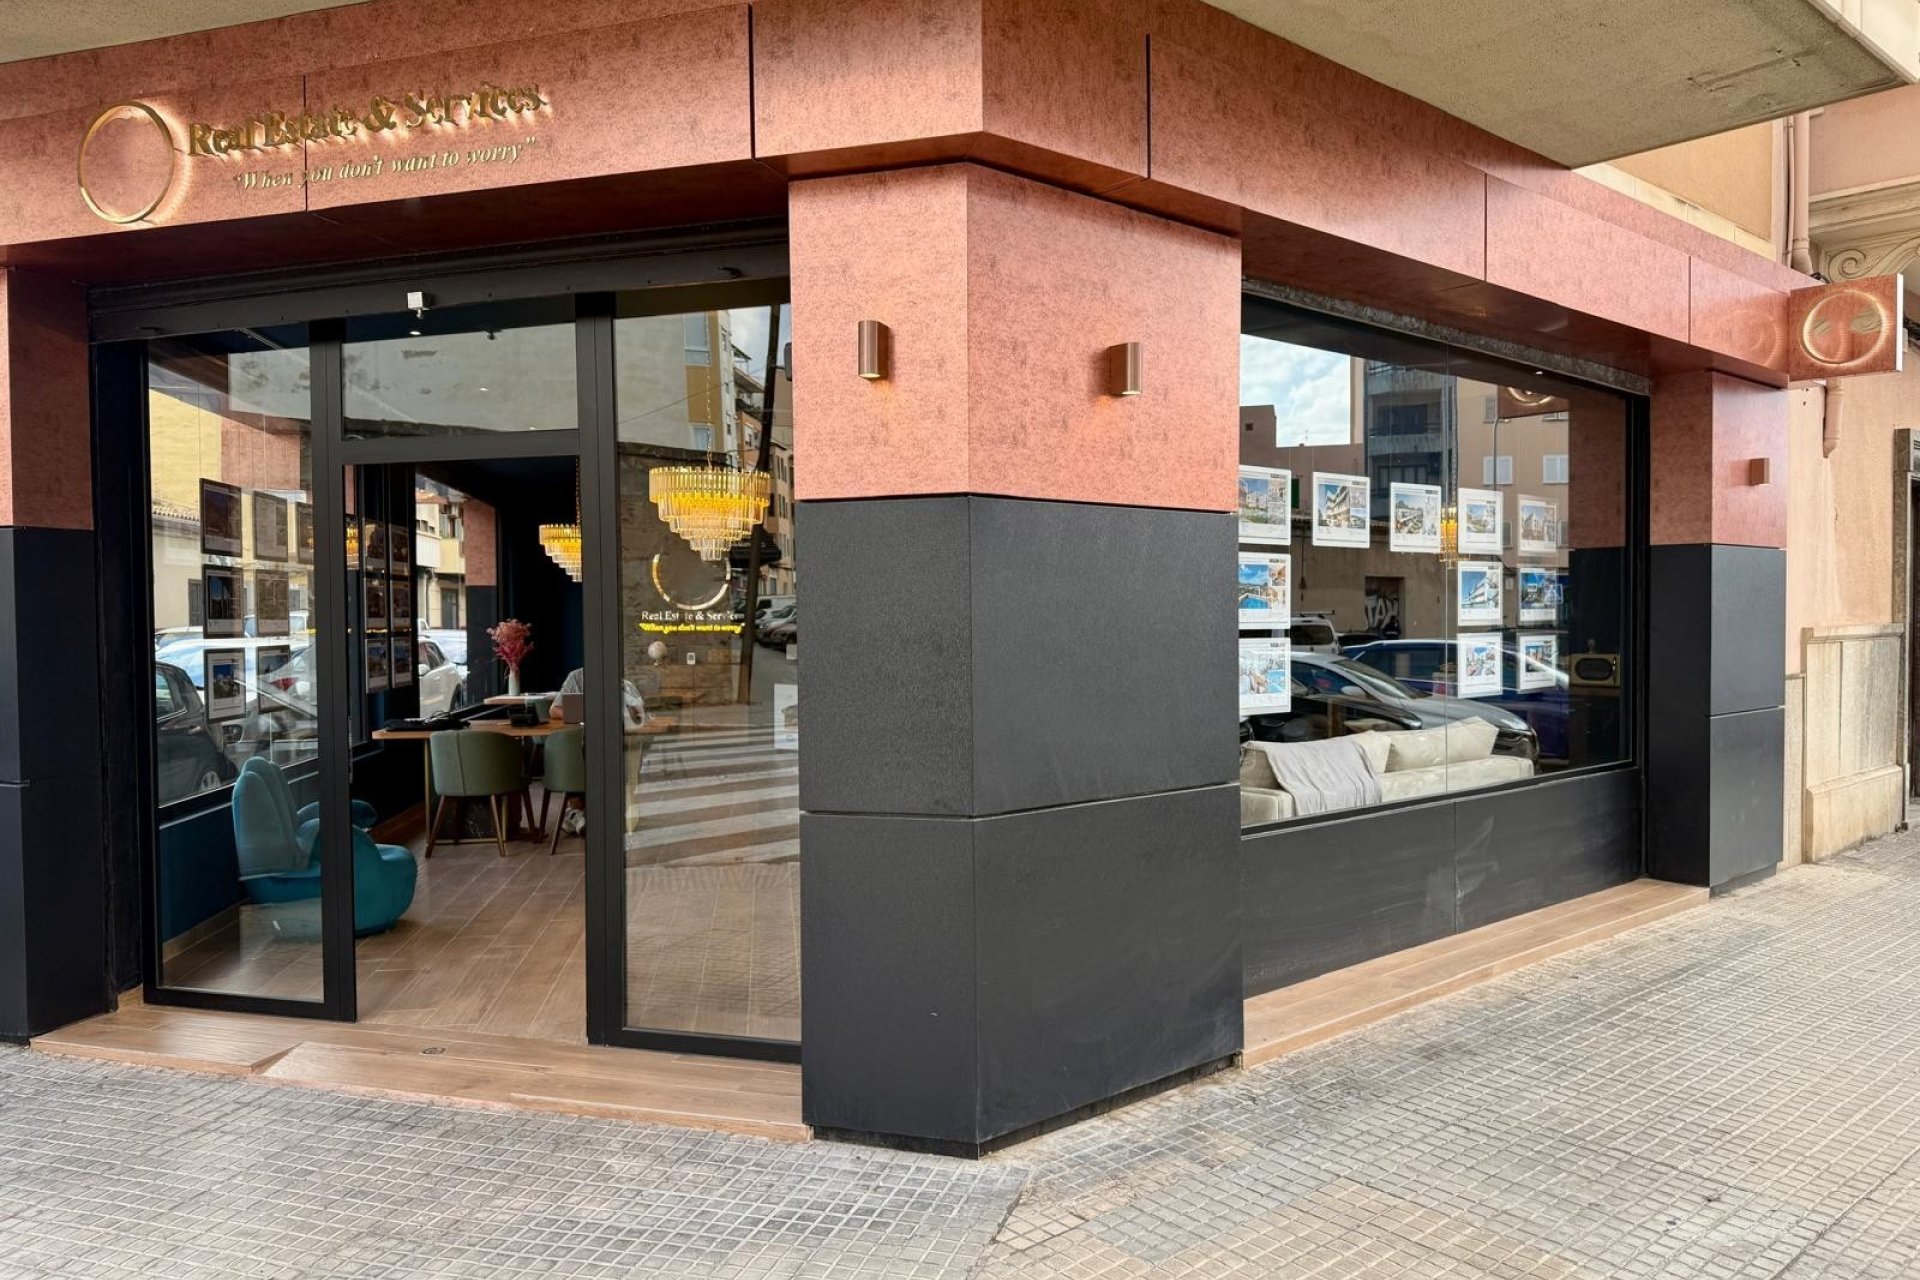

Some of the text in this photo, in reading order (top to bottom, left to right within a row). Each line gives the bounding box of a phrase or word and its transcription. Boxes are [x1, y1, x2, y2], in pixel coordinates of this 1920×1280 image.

[189, 82, 543, 156] Real Estate & Services
[300, 167, 332, 188] you
[392, 153, 438, 172] want
[442, 152, 460, 167] to
[641, 610, 662, 620] Real
